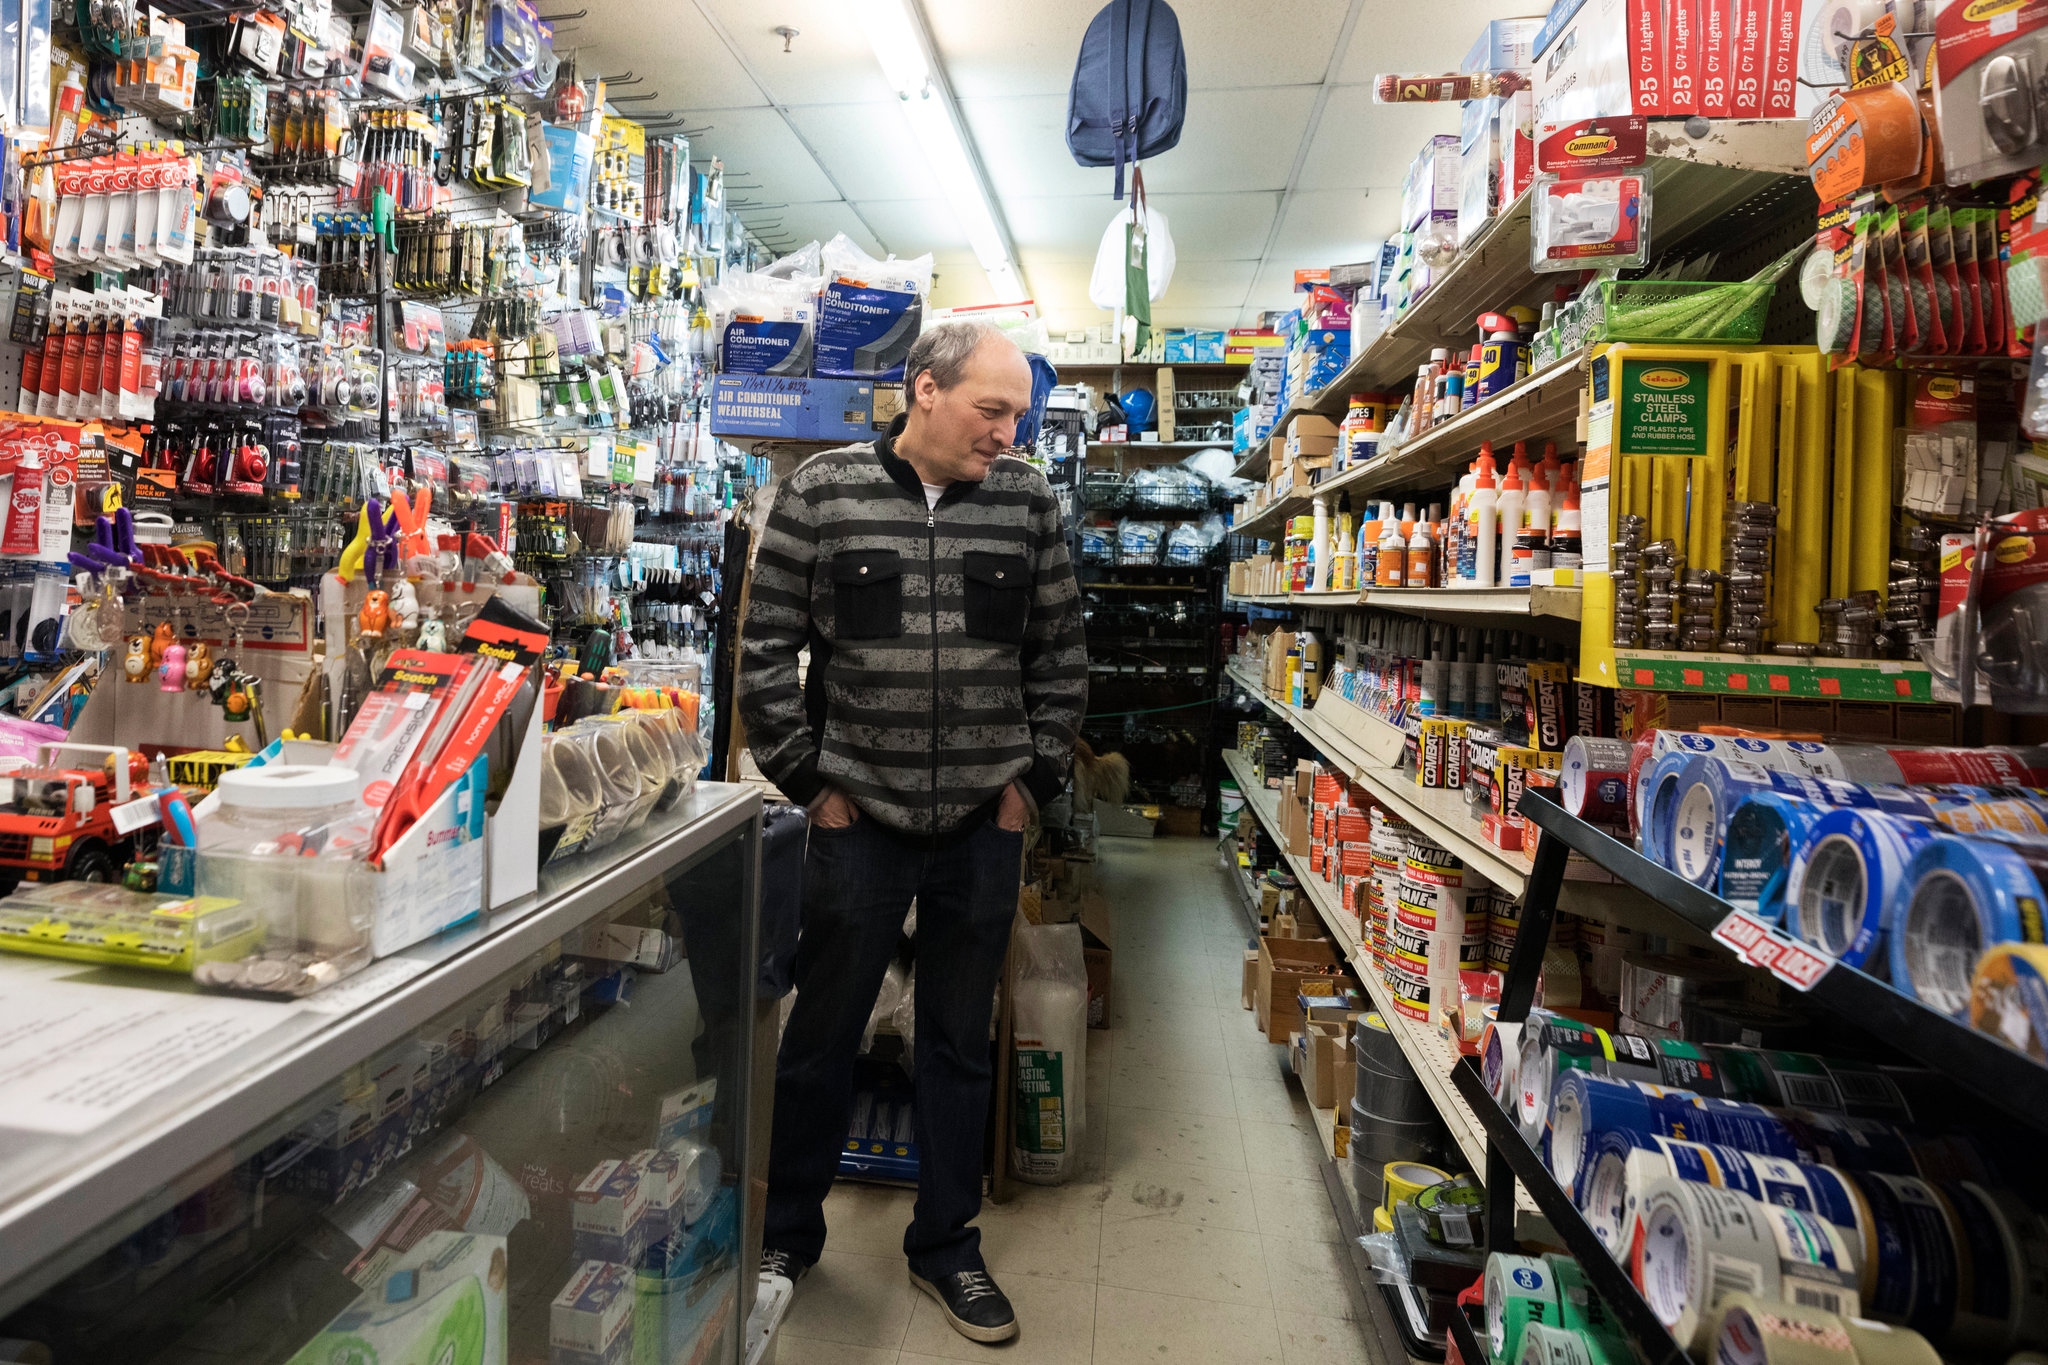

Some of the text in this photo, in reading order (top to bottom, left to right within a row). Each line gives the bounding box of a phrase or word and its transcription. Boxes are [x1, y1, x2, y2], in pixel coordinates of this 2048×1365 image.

[1877, 16, 1892, 28] CLEAR
[1640, 11, 1658, 106] 25 C7 Lights
[1673, 9, 1691, 105] 25 C7 Lights
[1705, 11, 1724, 106] 25 C7 Lights
[1737, 11, 1758, 107] 25 C7 Lights
[1772, 11, 1793, 108] 25 C7 Lights
[1556, 72, 1576, 101] Lights
[1814, 108, 1837, 135] CLEAR
[1811, 115, 1846, 154] GORILLA TAPE
[1569, 140, 1610, 151] Command
[2010, 196, 2038, 220] Scotch
[1818, 208, 1850, 229] Scotch
[827, 290, 841, 299] AIR
[825, 298, 890, 315] CONDITIONER
[730, 336, 789, 346] CONDITIONER
[718, 391, 800, 406] AIR CONDITIONER
[1633, 393, 1695, 404] STAINLESS
[717, 405, 782, 419] WEATHERSEAL
[1646, 404, 1682, 413] STEEL
[1641, 413, 1687, 423] CLAMPS
[16, 493, 41, 502] Shoe
[172, 524, 202, 535] Master
[477, 643, 516, 661] Scotch
[393, 670, 439, 685] Scotch
[1497, 664, 1528, 688] COMBAT
[1539, 680, 1558, 747] COMBAT
[382, 700, 432, 774] PRECISION
[465, 714, 489, 746] home
[1694, 735, 1709, 750] ipg
[1425, 730, 1438, 786] COMBAT
[1448, 731, 1460, 788] COMBAT
[1471, 742, 1499, 771] COMBAT
[1604, 781, 1619, 803] ipg
[1424, 873, 1445, 883] PURPOSE
[1446, 877, 1458, 886] TAPE
[1421, 916, 1433, 926] TAPE
[1414, 963, 1424, 972] TAPE
[1414, 1009, 1425, 1019] TAPE
[1019, 1056, 1033, 1067] MIL
[1524, 1091, 1534, 1107] 3M
[566, 1272, 592, 1301] LENOX
[1519, 1270, 1533, 1288] ipg
